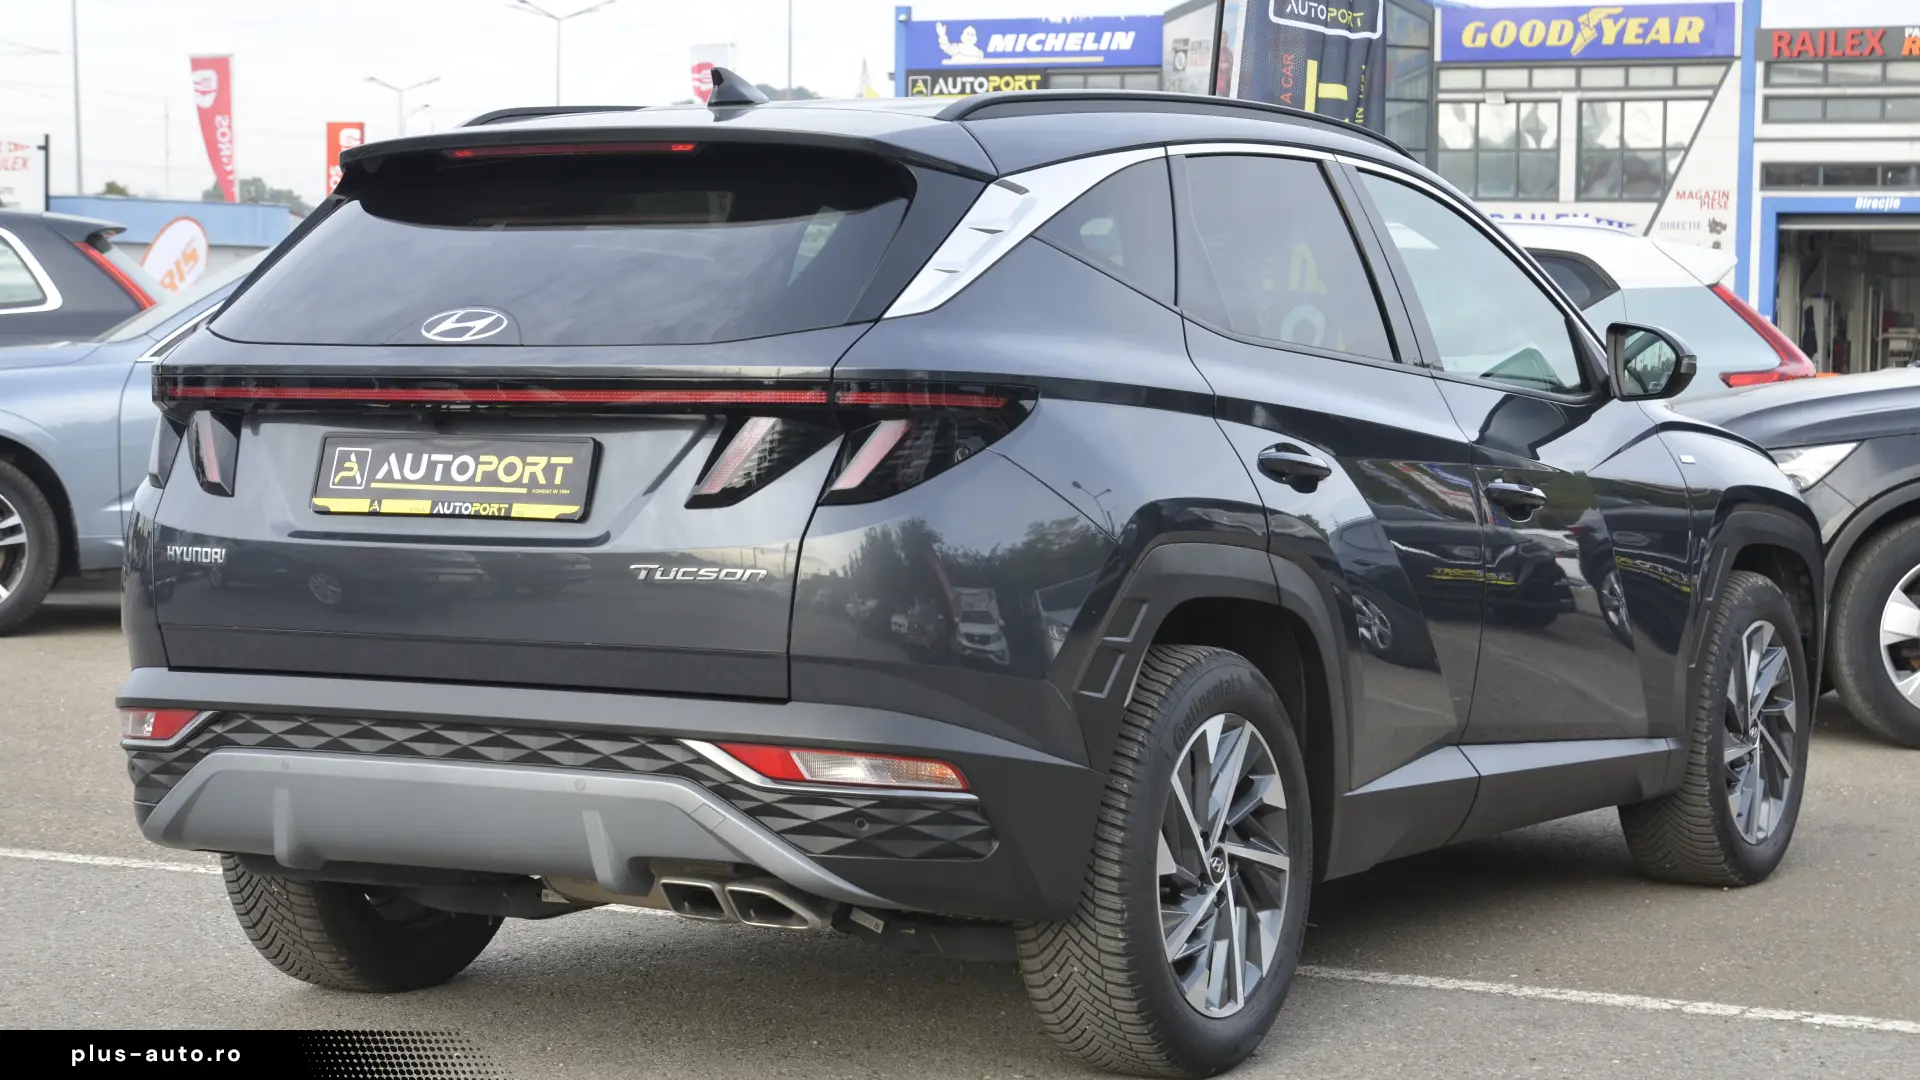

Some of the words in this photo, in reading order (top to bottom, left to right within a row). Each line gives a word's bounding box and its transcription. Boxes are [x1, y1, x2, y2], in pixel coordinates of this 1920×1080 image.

[1285, 0, 1365, 28] AUTOPORT
[986, 31, 1136, 53] MICHELIN
[1461, 16, 1705, 48] GOODYEAR
[1771, 28, 1887, 59] RAILEX
[1281, 53, 1295, 88] CAR
[932, 75, 1042, 94] AUTOPORT
[1675, 190, 1730, 201] MAGAZIN
[1699, 199, 1729, 210] PIESE
[374, 452, 574, 485] AUTOPORT
[433, 501, 509, 516] AUTOPORT
[166, 545, 227, 564] HYUNDAI
